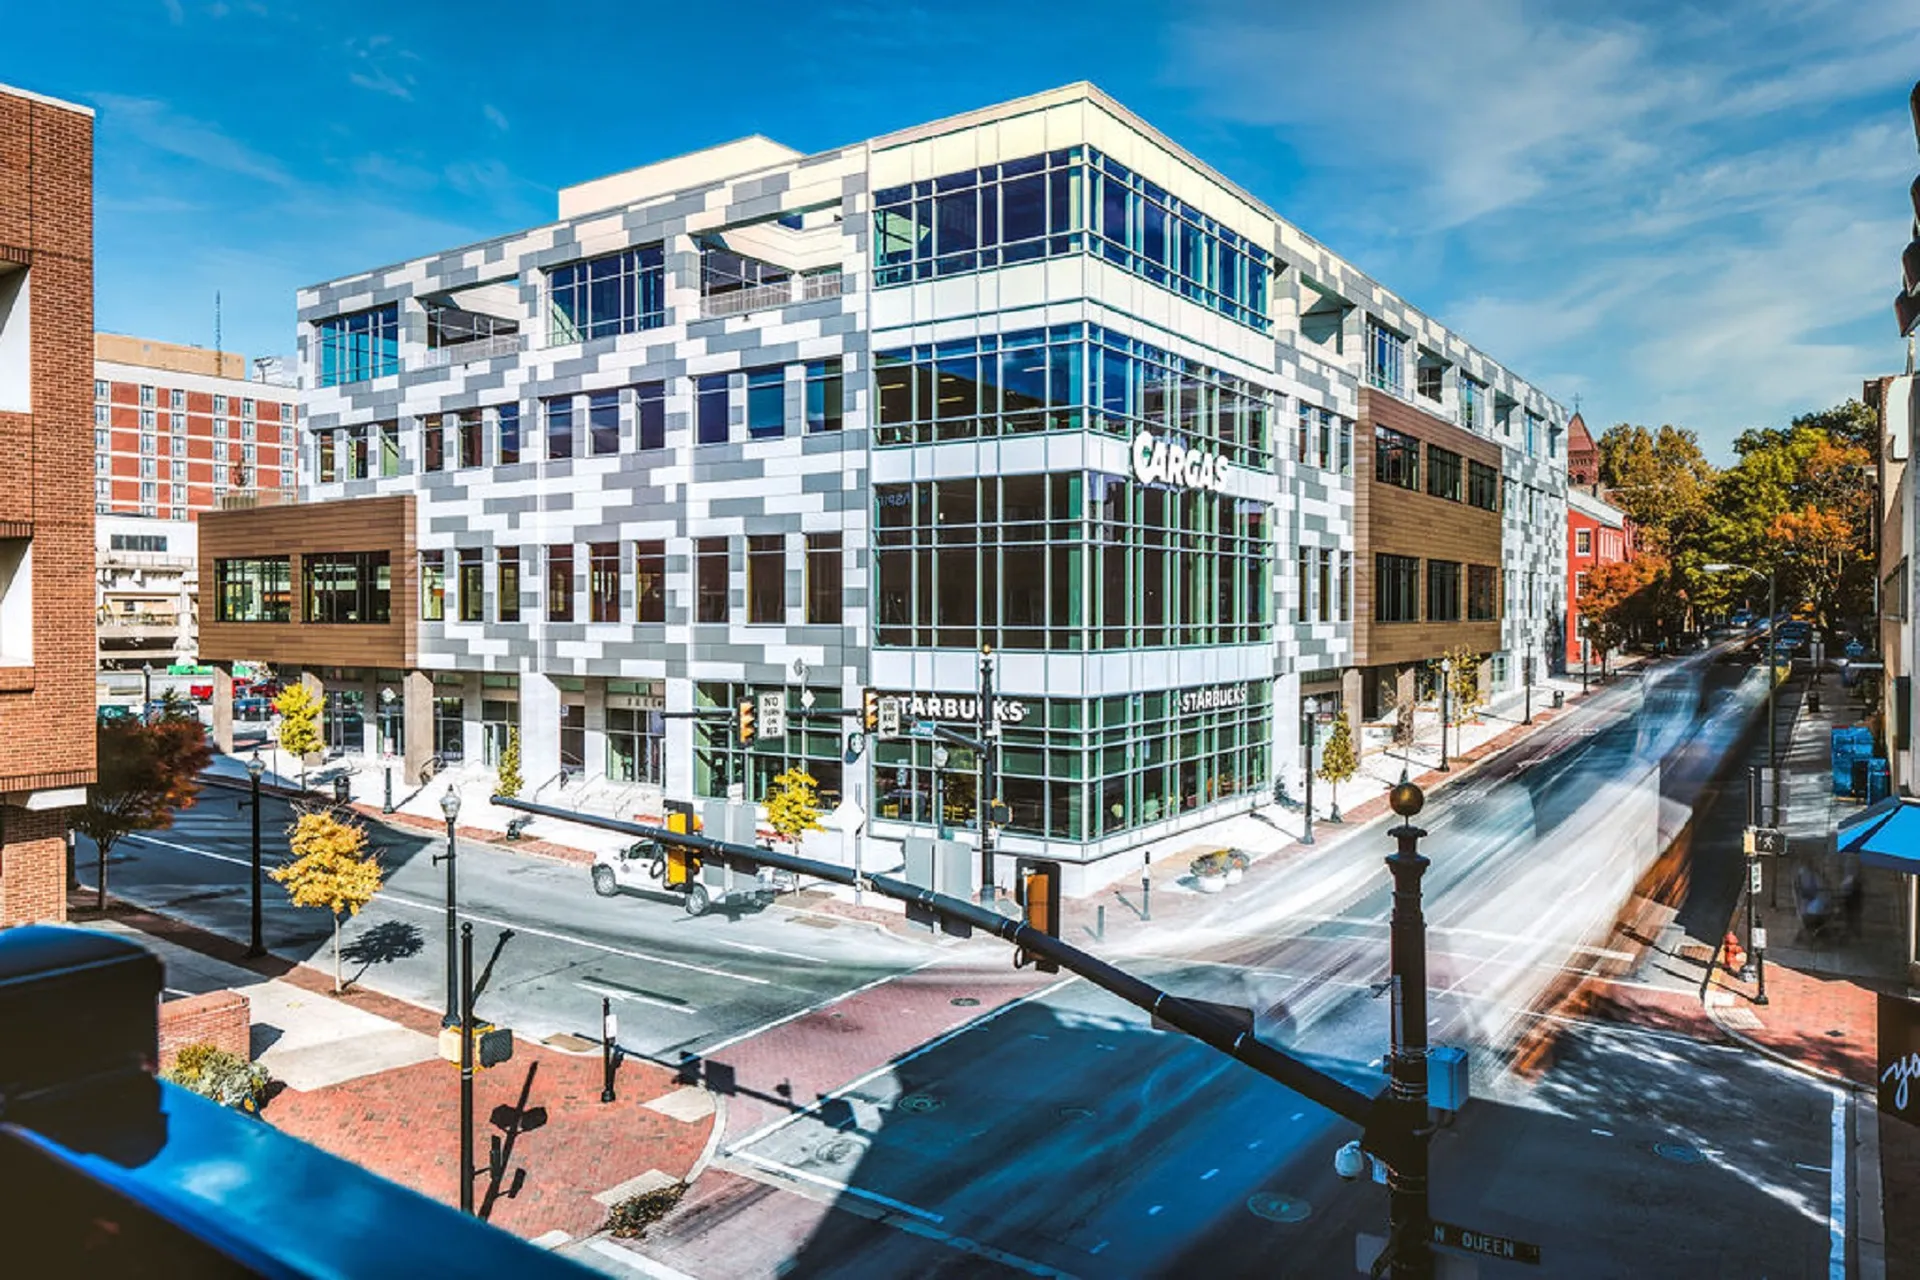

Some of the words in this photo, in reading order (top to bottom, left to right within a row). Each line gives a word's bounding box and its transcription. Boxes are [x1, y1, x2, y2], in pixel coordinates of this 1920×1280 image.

[1133, 431, 1228, 493] CARGAS
[764, 697, 778, 707] NO
[883, 702, 895, 711] ONE
[1182, 686, 1247, 712] STARBUCKS
[883, 713, 895, 722] WAY
[900, 697, 1025, 722] TARBUKS
[766, 727, 778, 735] RED
[1434, 1225, 1445, 1242] N
[1462, 1231, 1515, 1257] QUEEN
